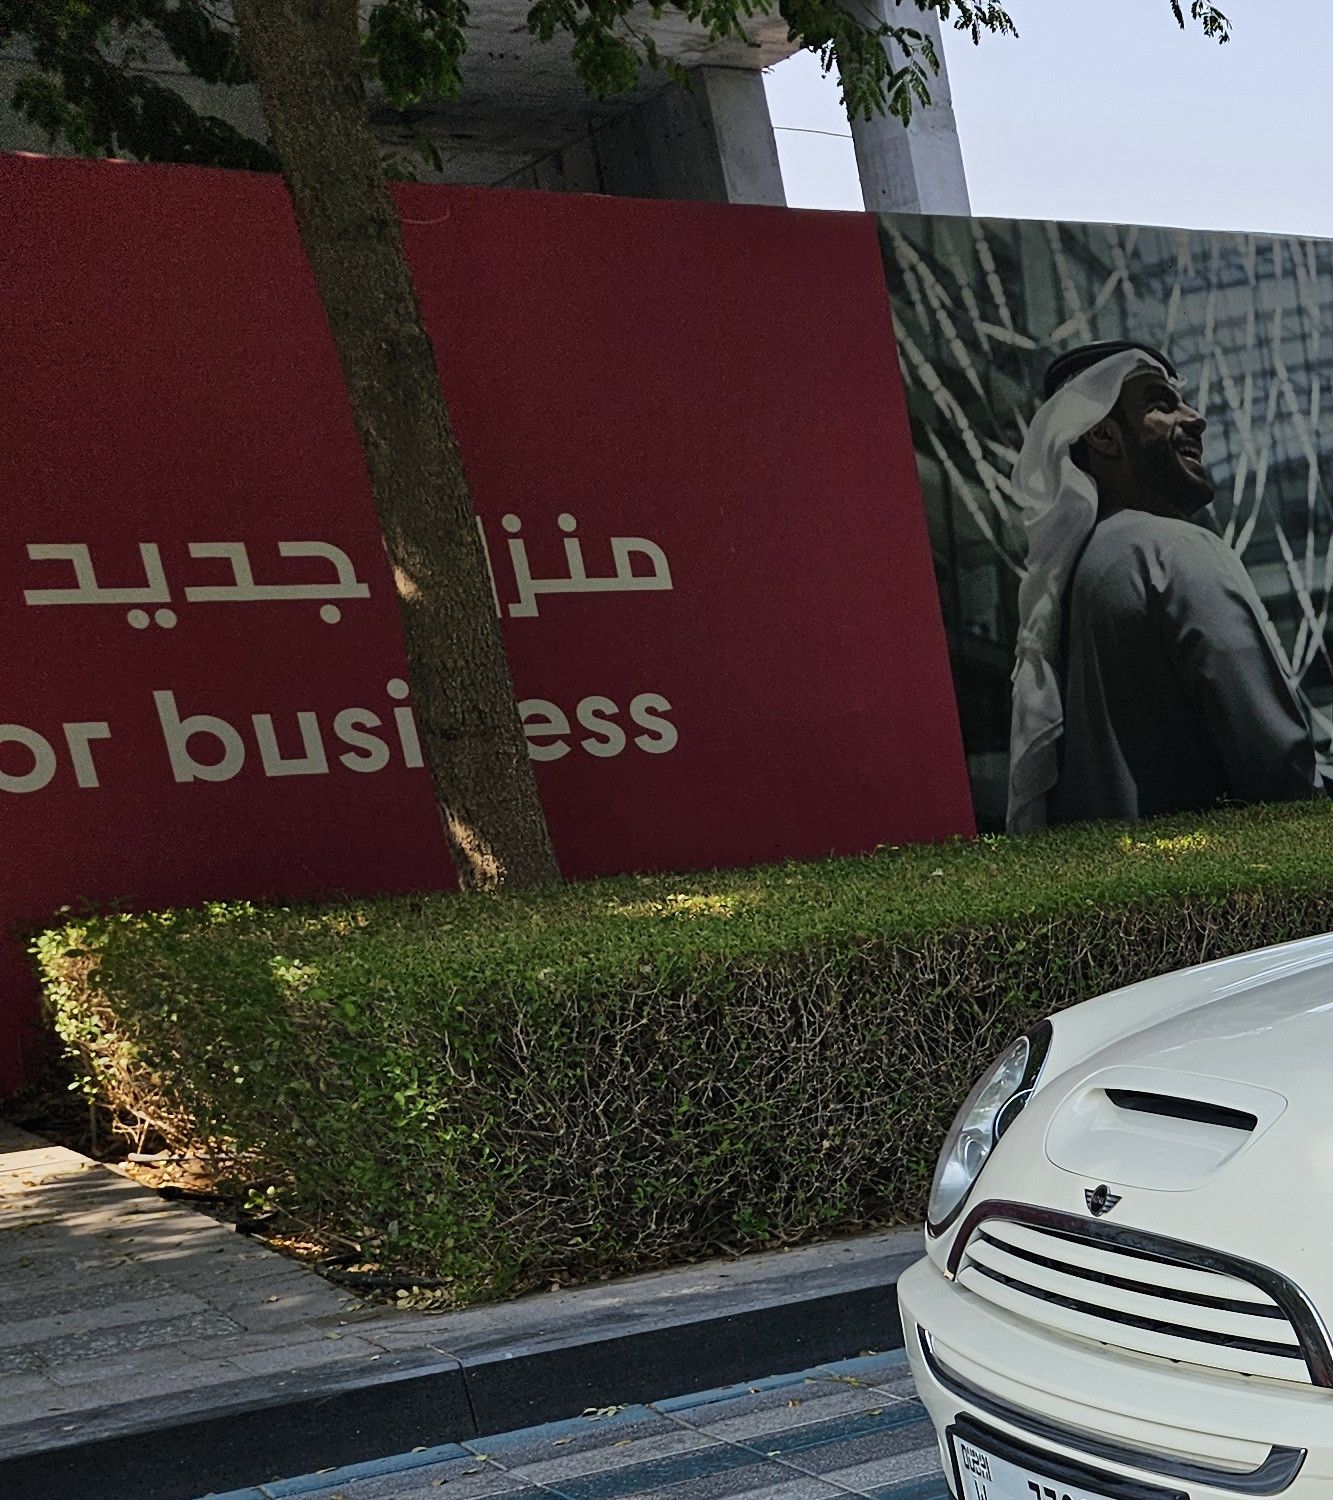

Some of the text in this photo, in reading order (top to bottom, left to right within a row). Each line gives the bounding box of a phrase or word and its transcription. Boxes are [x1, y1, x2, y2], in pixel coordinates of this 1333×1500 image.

[23, 513, 674, 629] منز جديد
[153, 678, 679, 783] busiess
